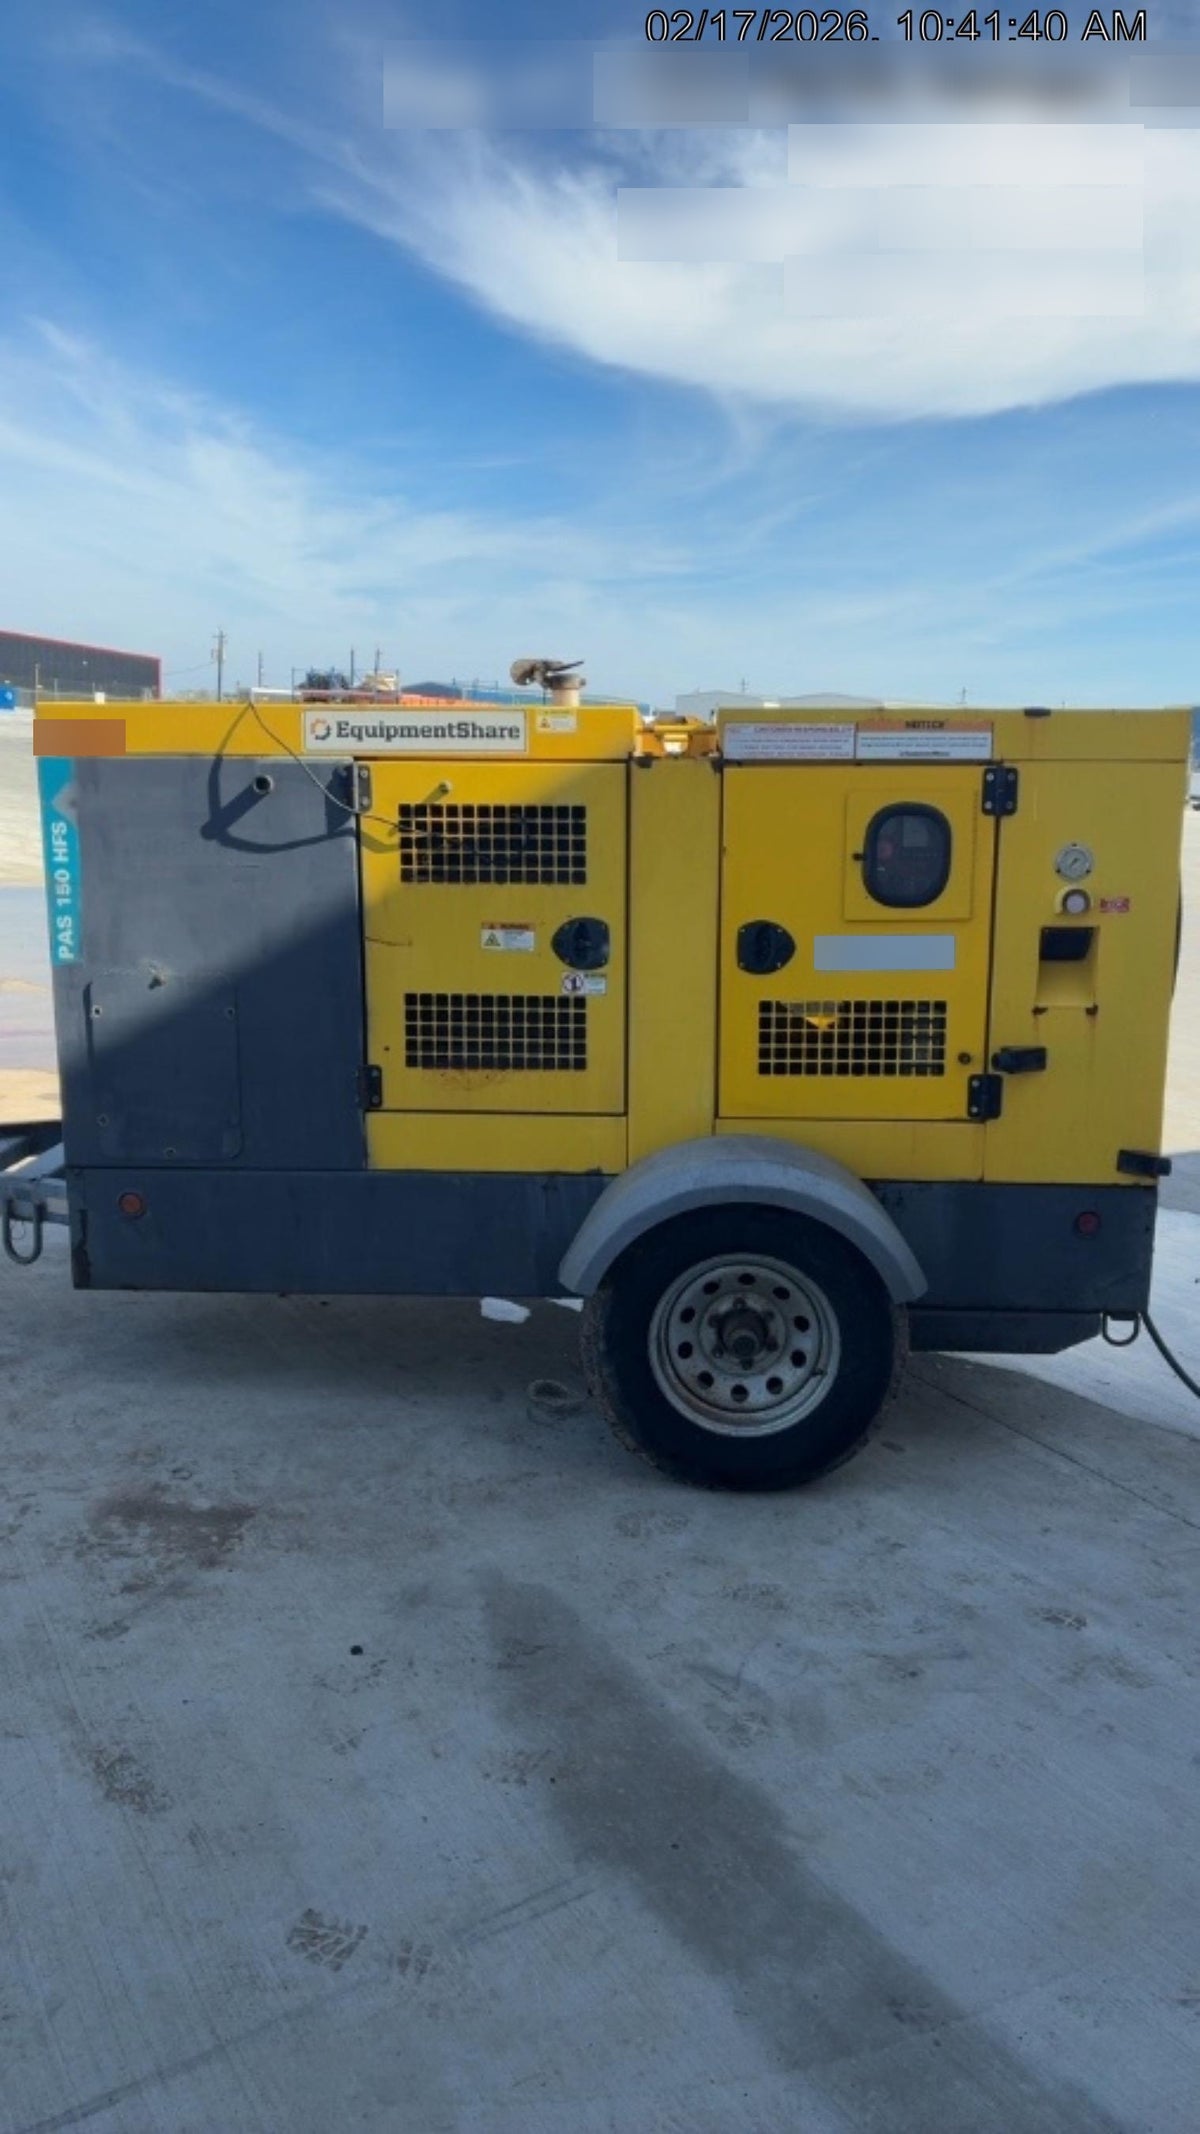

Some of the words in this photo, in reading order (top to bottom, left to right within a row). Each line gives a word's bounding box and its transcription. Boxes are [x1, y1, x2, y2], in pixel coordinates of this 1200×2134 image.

[336, 720, 520, 742] EquipmentShare
[52, 821, 70, 863] HFS
[54, 869, 72, 907] 150
[56, 915, 75, 961] PAS
